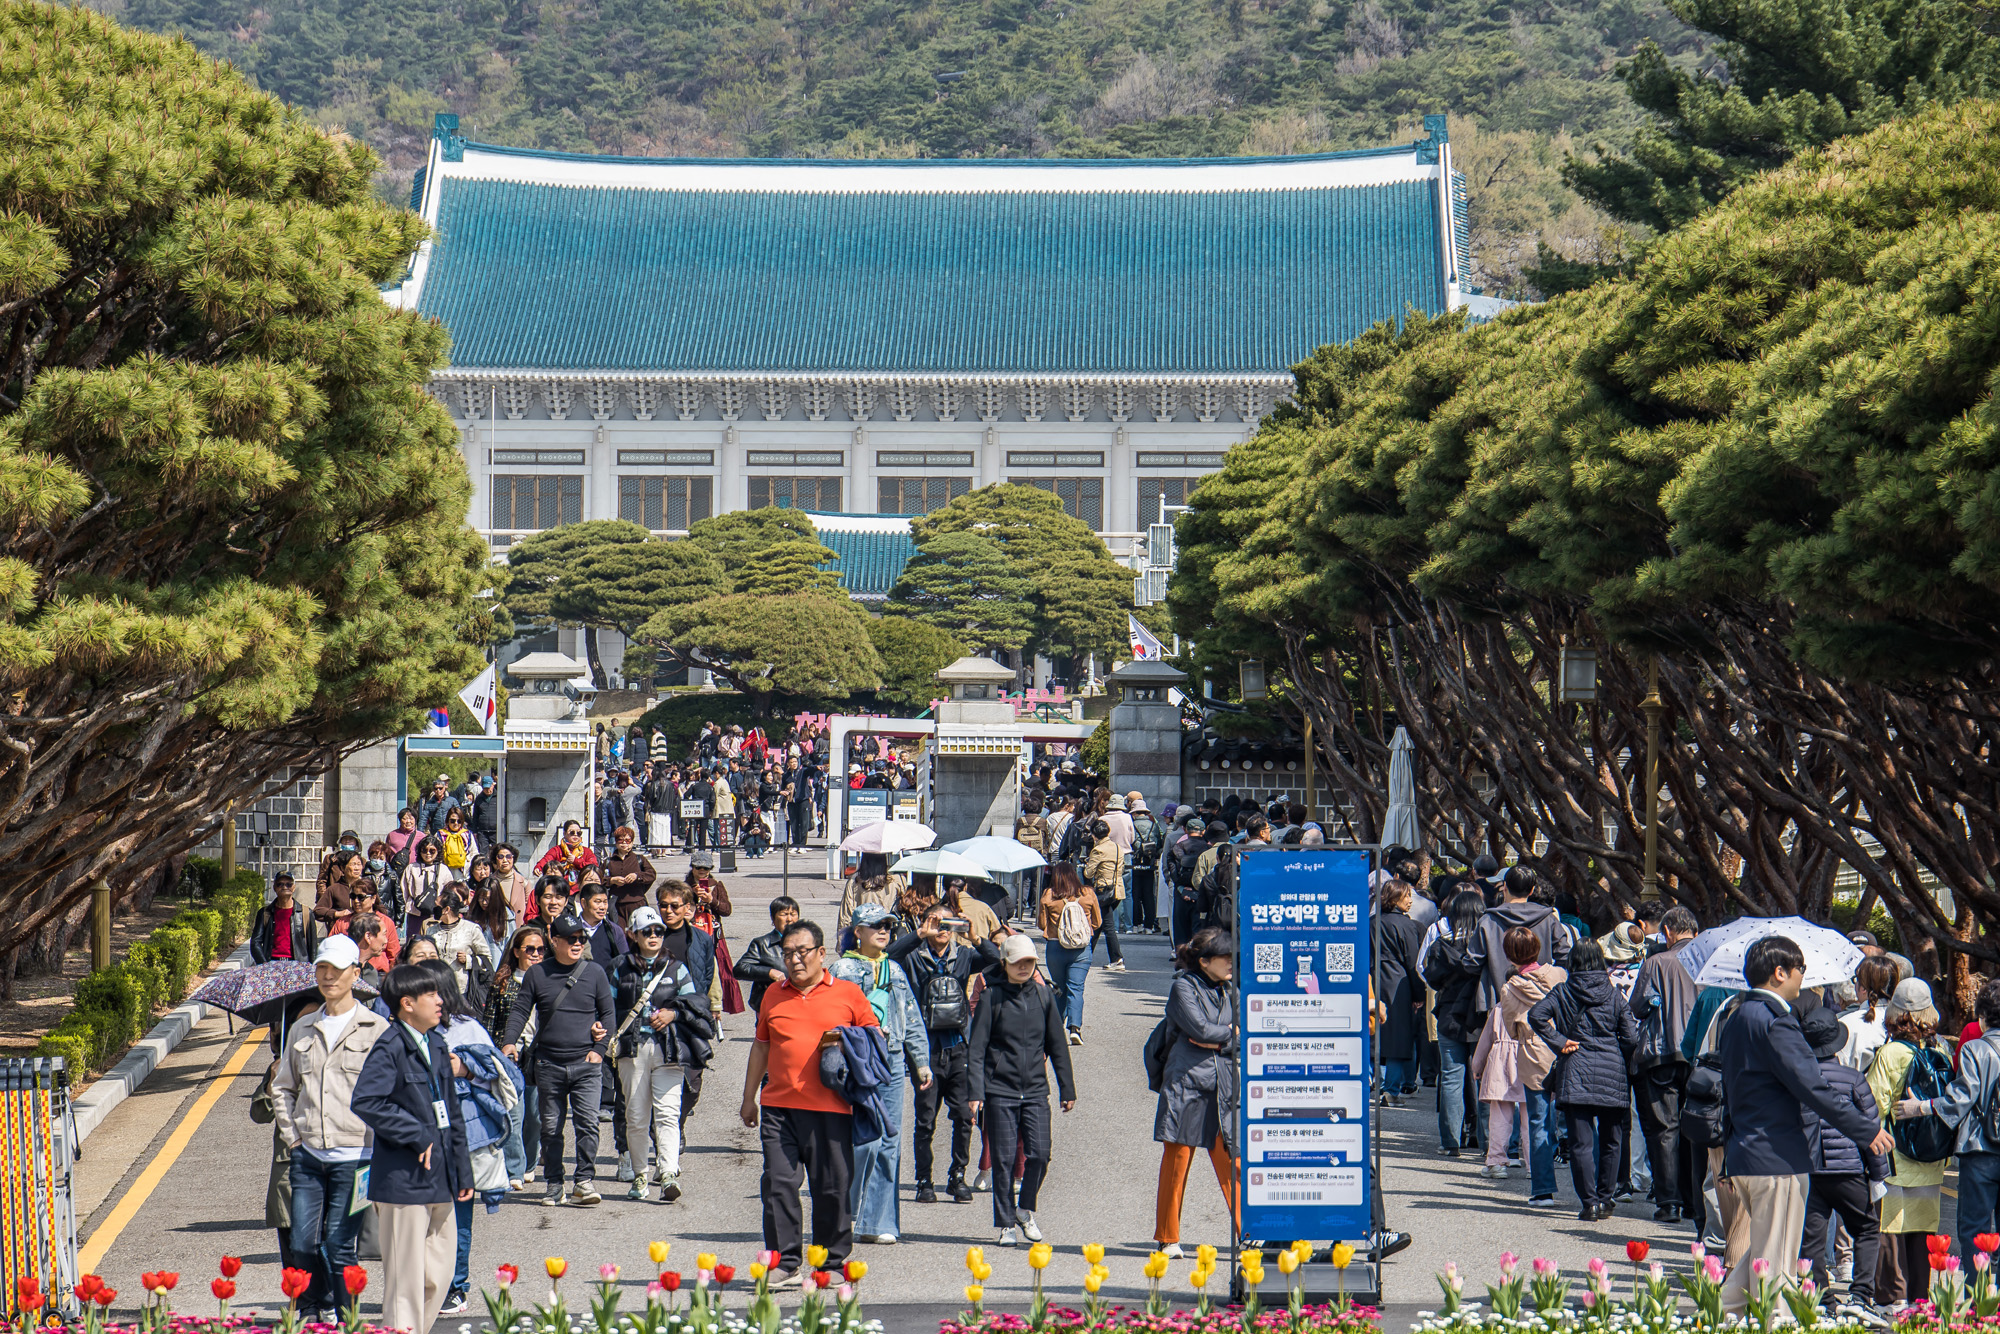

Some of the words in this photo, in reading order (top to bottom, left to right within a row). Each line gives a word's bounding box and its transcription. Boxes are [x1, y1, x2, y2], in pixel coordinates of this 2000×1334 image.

[1280, 894, 1298, 902] 청와대
[1299, 894, 1316, 902] 관람을
[1317, 894, 1329, 902] 위한
[1251, 904, 1320, 924] 현장예약
[1325, 904, 1358, 924] 방법
